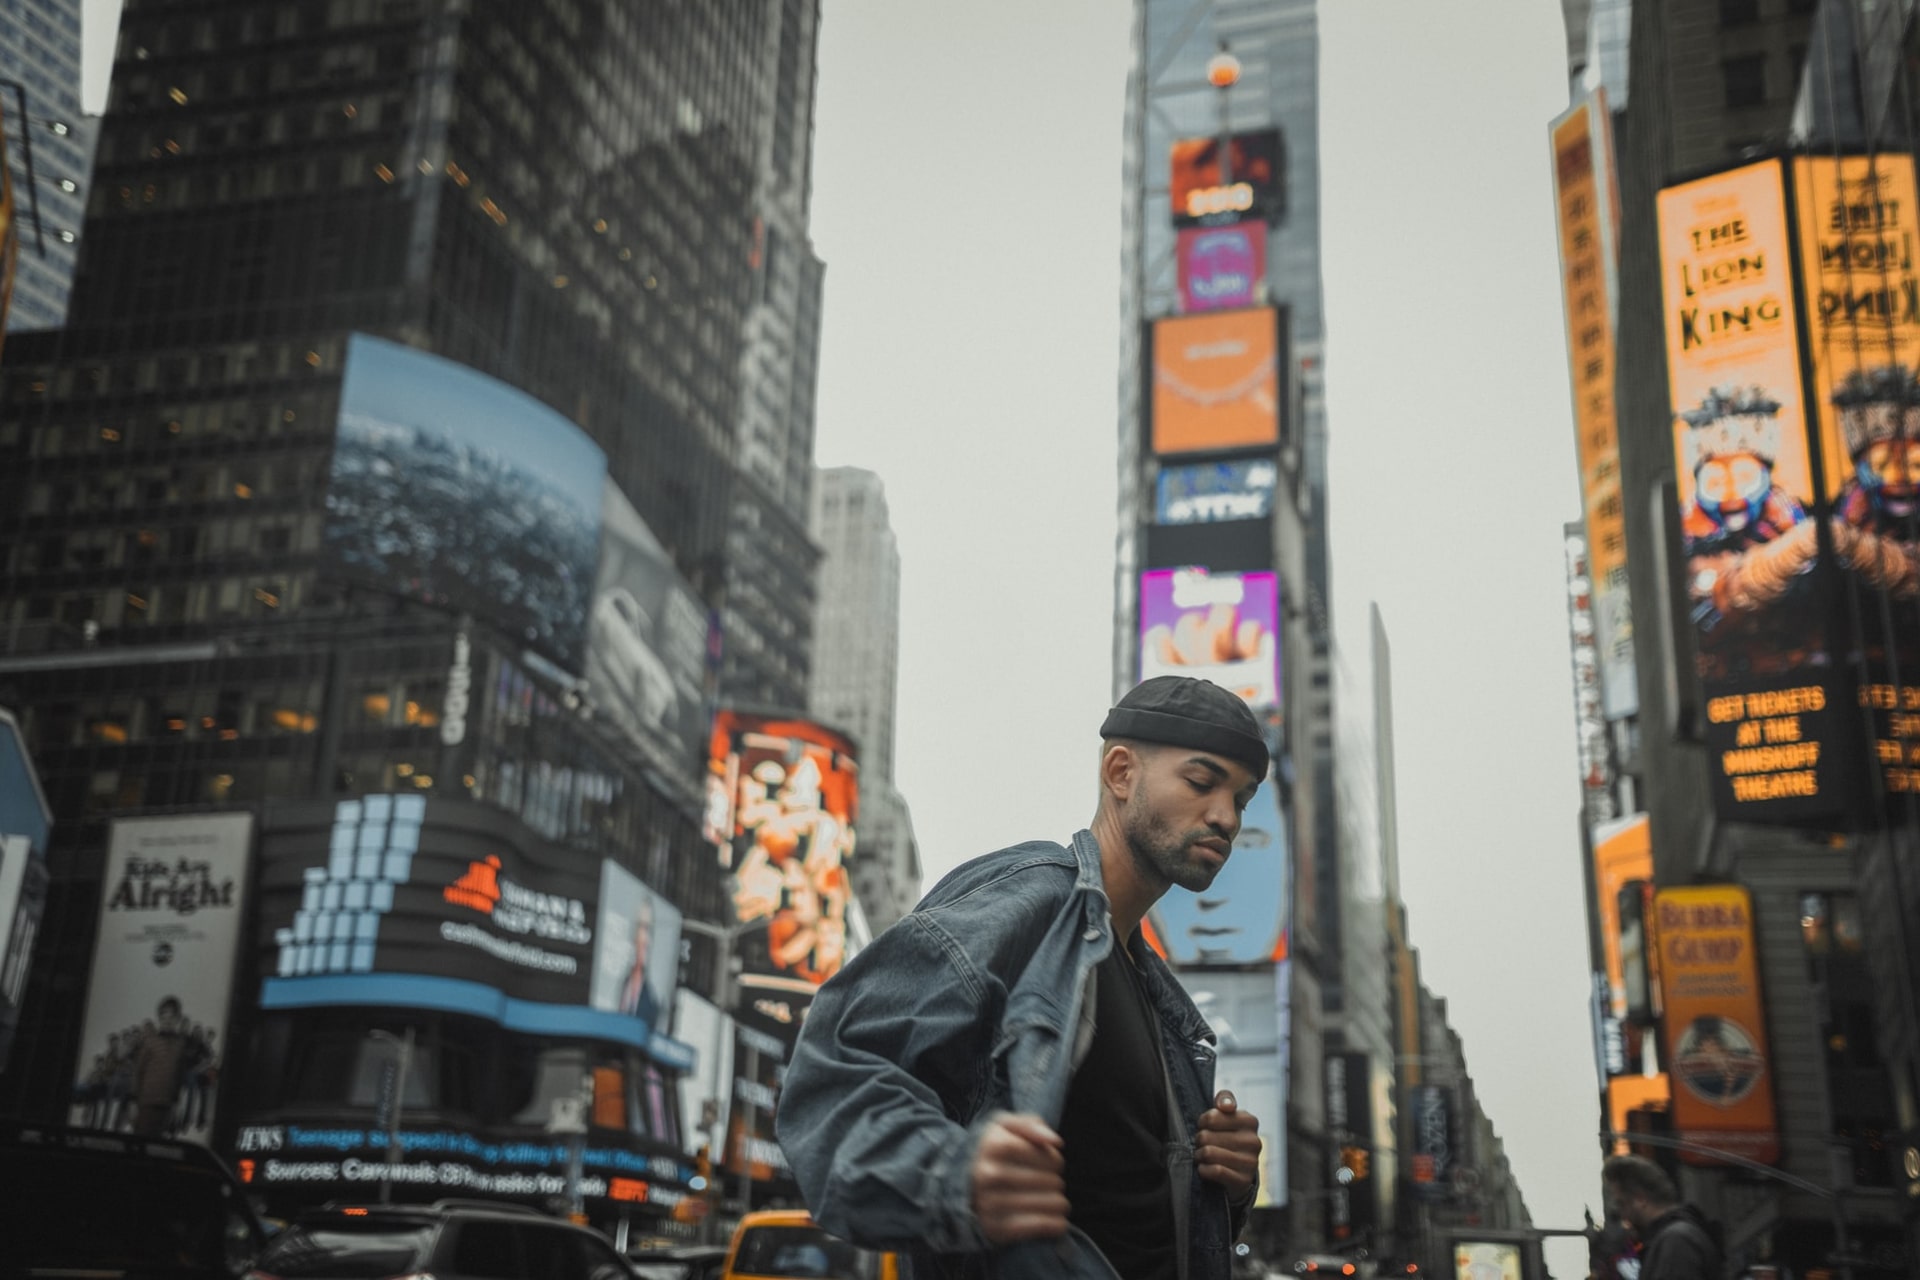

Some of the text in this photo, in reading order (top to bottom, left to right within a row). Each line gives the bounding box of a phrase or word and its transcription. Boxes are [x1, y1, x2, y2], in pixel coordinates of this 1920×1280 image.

[1692, 220, 1748, 251] THE
[1682, 254, 1764, 297] LION
[1680, 300, 1781, 351] KING
[1707, 685, 1826, 723] GET TICKETS
[1736, 716, 1802, 747] AT THE
[109, 874, 235, 916] Alright
